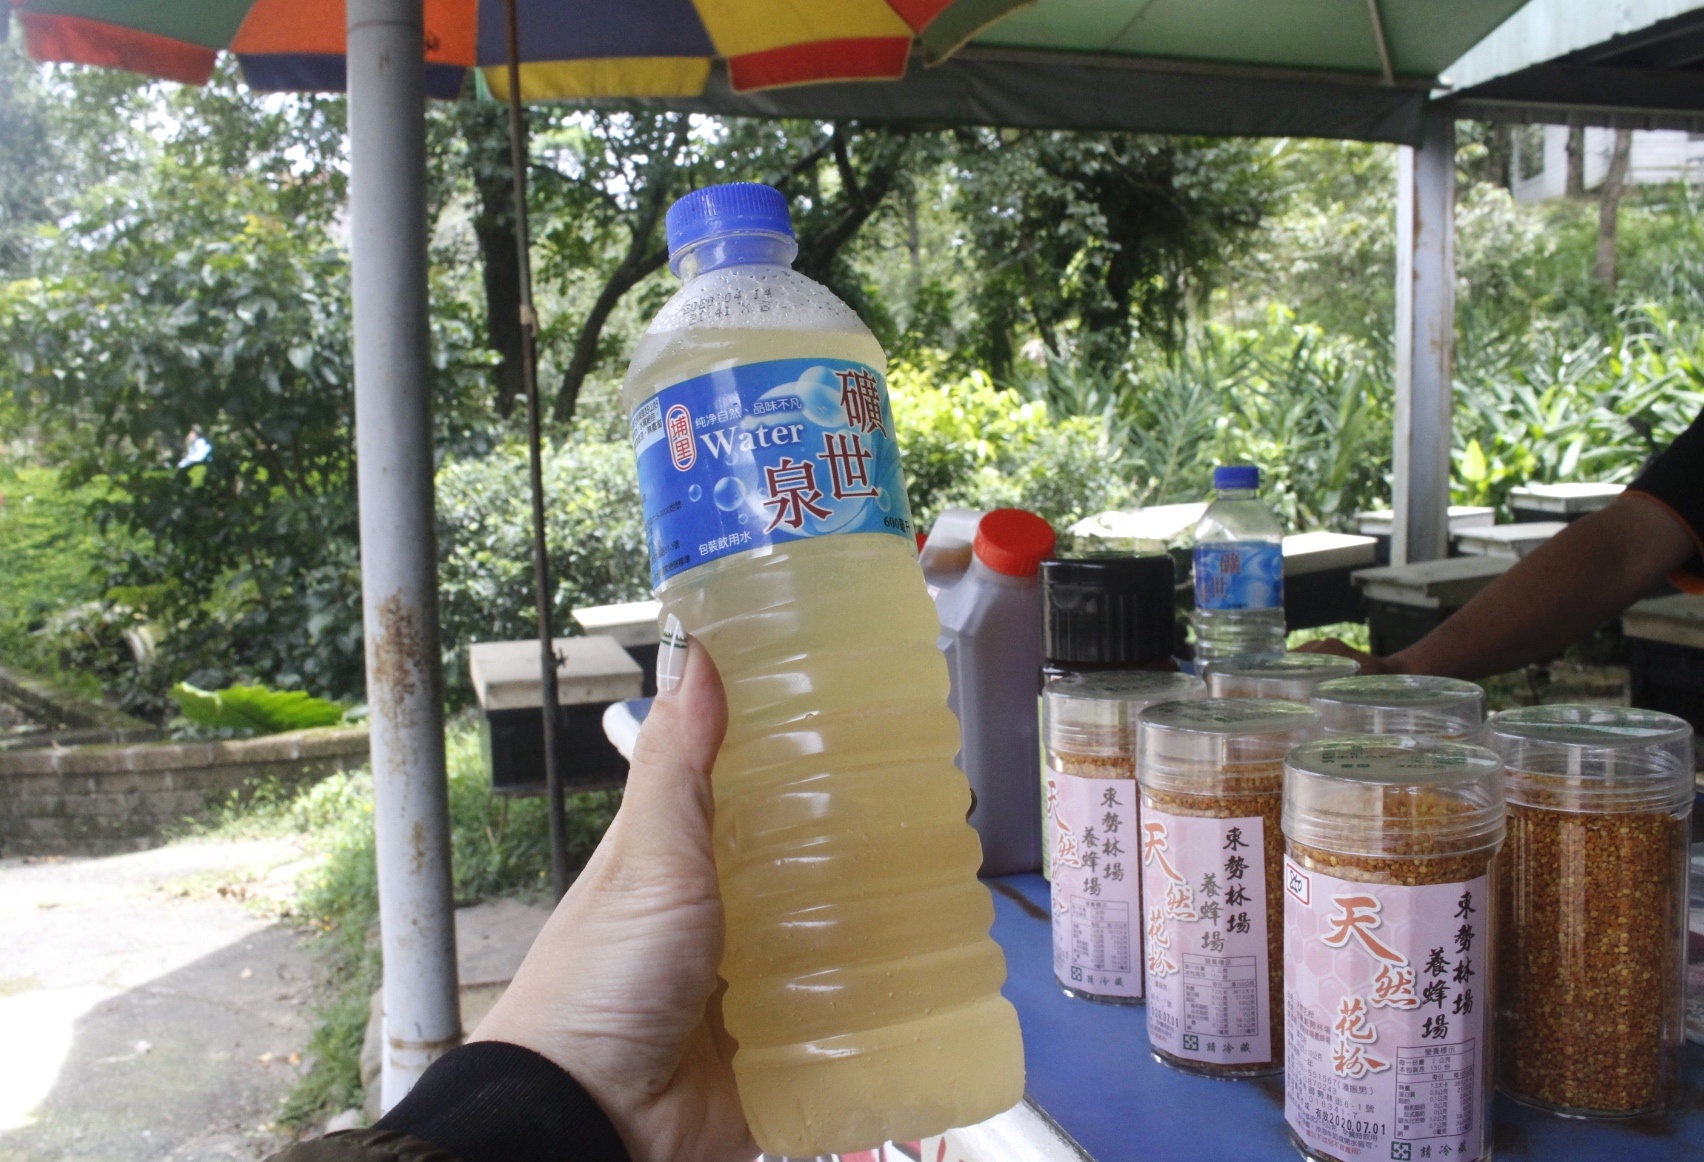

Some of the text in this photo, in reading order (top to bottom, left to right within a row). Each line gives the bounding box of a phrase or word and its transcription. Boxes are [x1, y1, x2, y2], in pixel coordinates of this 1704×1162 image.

[670, 414, 693, 461] 埔里
[700, 424, 804, 459] Water
[699, 531, 752, 556] 包裝飲用水
[1082, 826, 1101, 897] 養蜂場
[1100, 786, 1125, 882] 東勢林場
[1200, 873, 1225, 953] 養蜂場
[1223, 827, 1252, 934] 東勢林場
[1452, 891, 1476, 1015] 東勢林場
[1421, 947, 1451, 1040] 養蜂場
